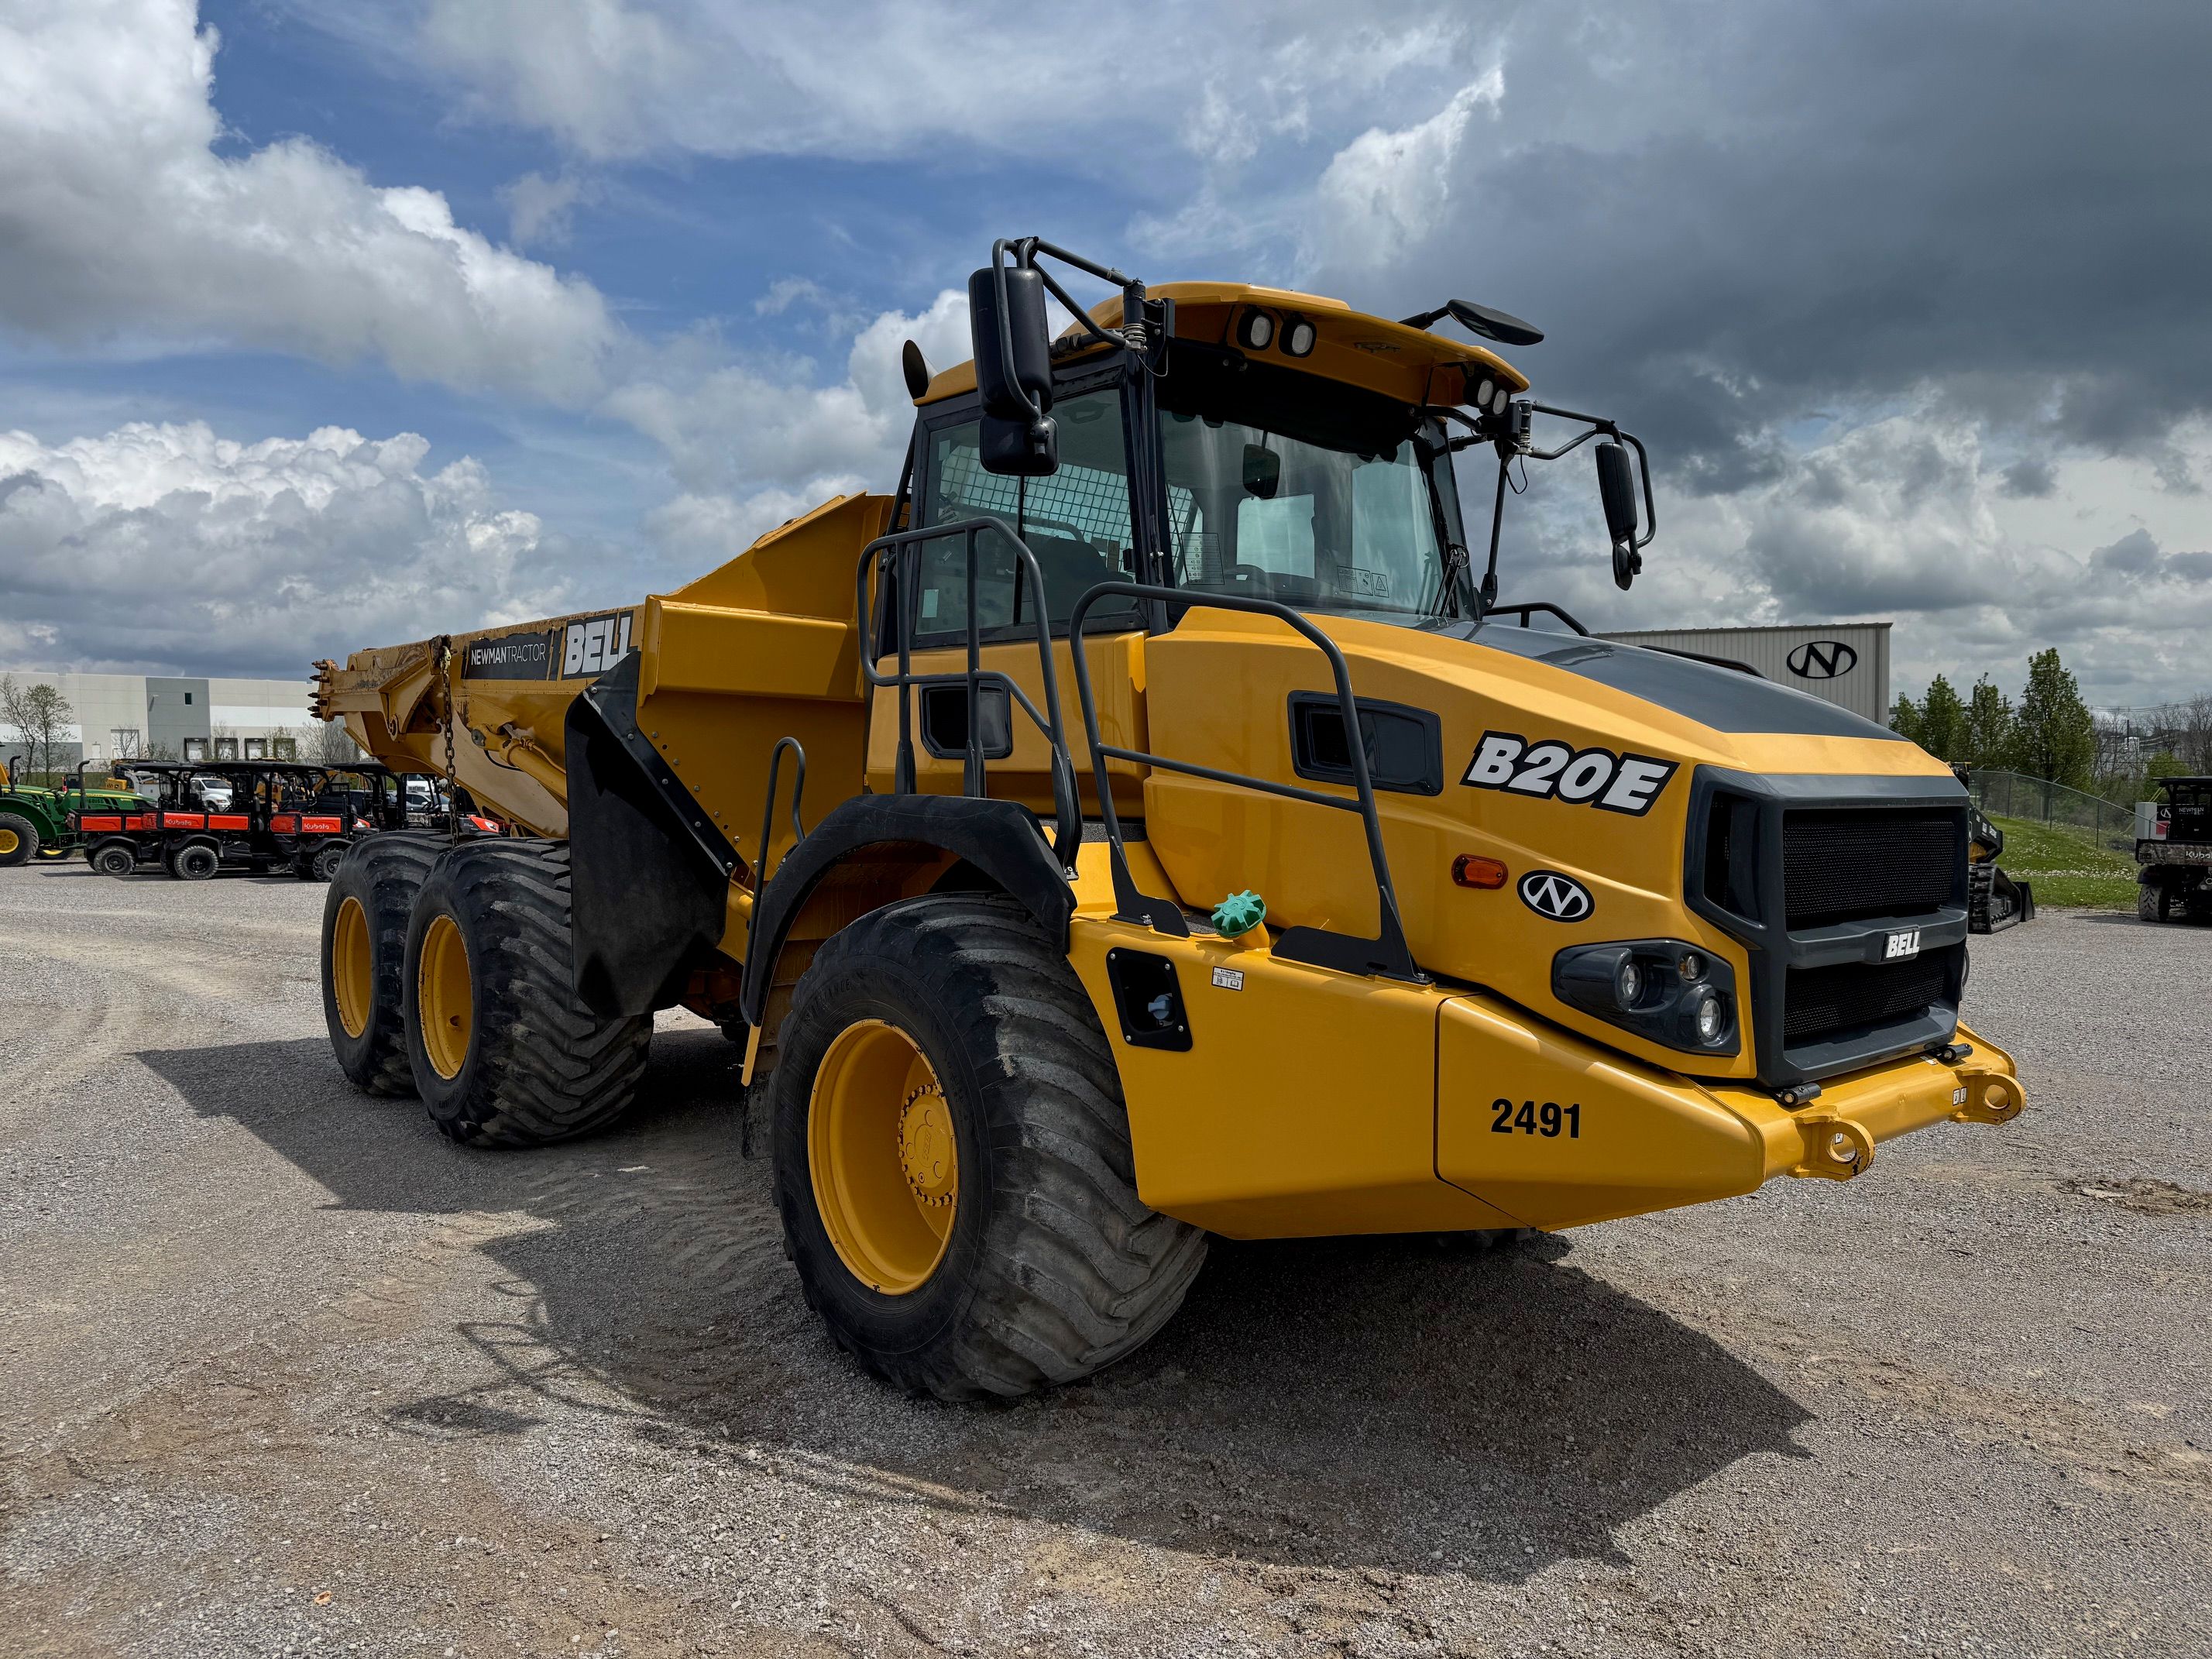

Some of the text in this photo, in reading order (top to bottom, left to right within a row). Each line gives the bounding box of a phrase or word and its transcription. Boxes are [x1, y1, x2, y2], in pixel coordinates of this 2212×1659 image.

[564, 617, 631, 675] BELL
[1787, 641, 1857, 678] N
[1467, 736, 1670, 810] B20E
[2186, 850, 2212, 859] Kubo
[1523, 874, 1589, 918] N
[1886, 931, 1920, 958] BELL
[1491, 1098, 1580, 1139] 2491
